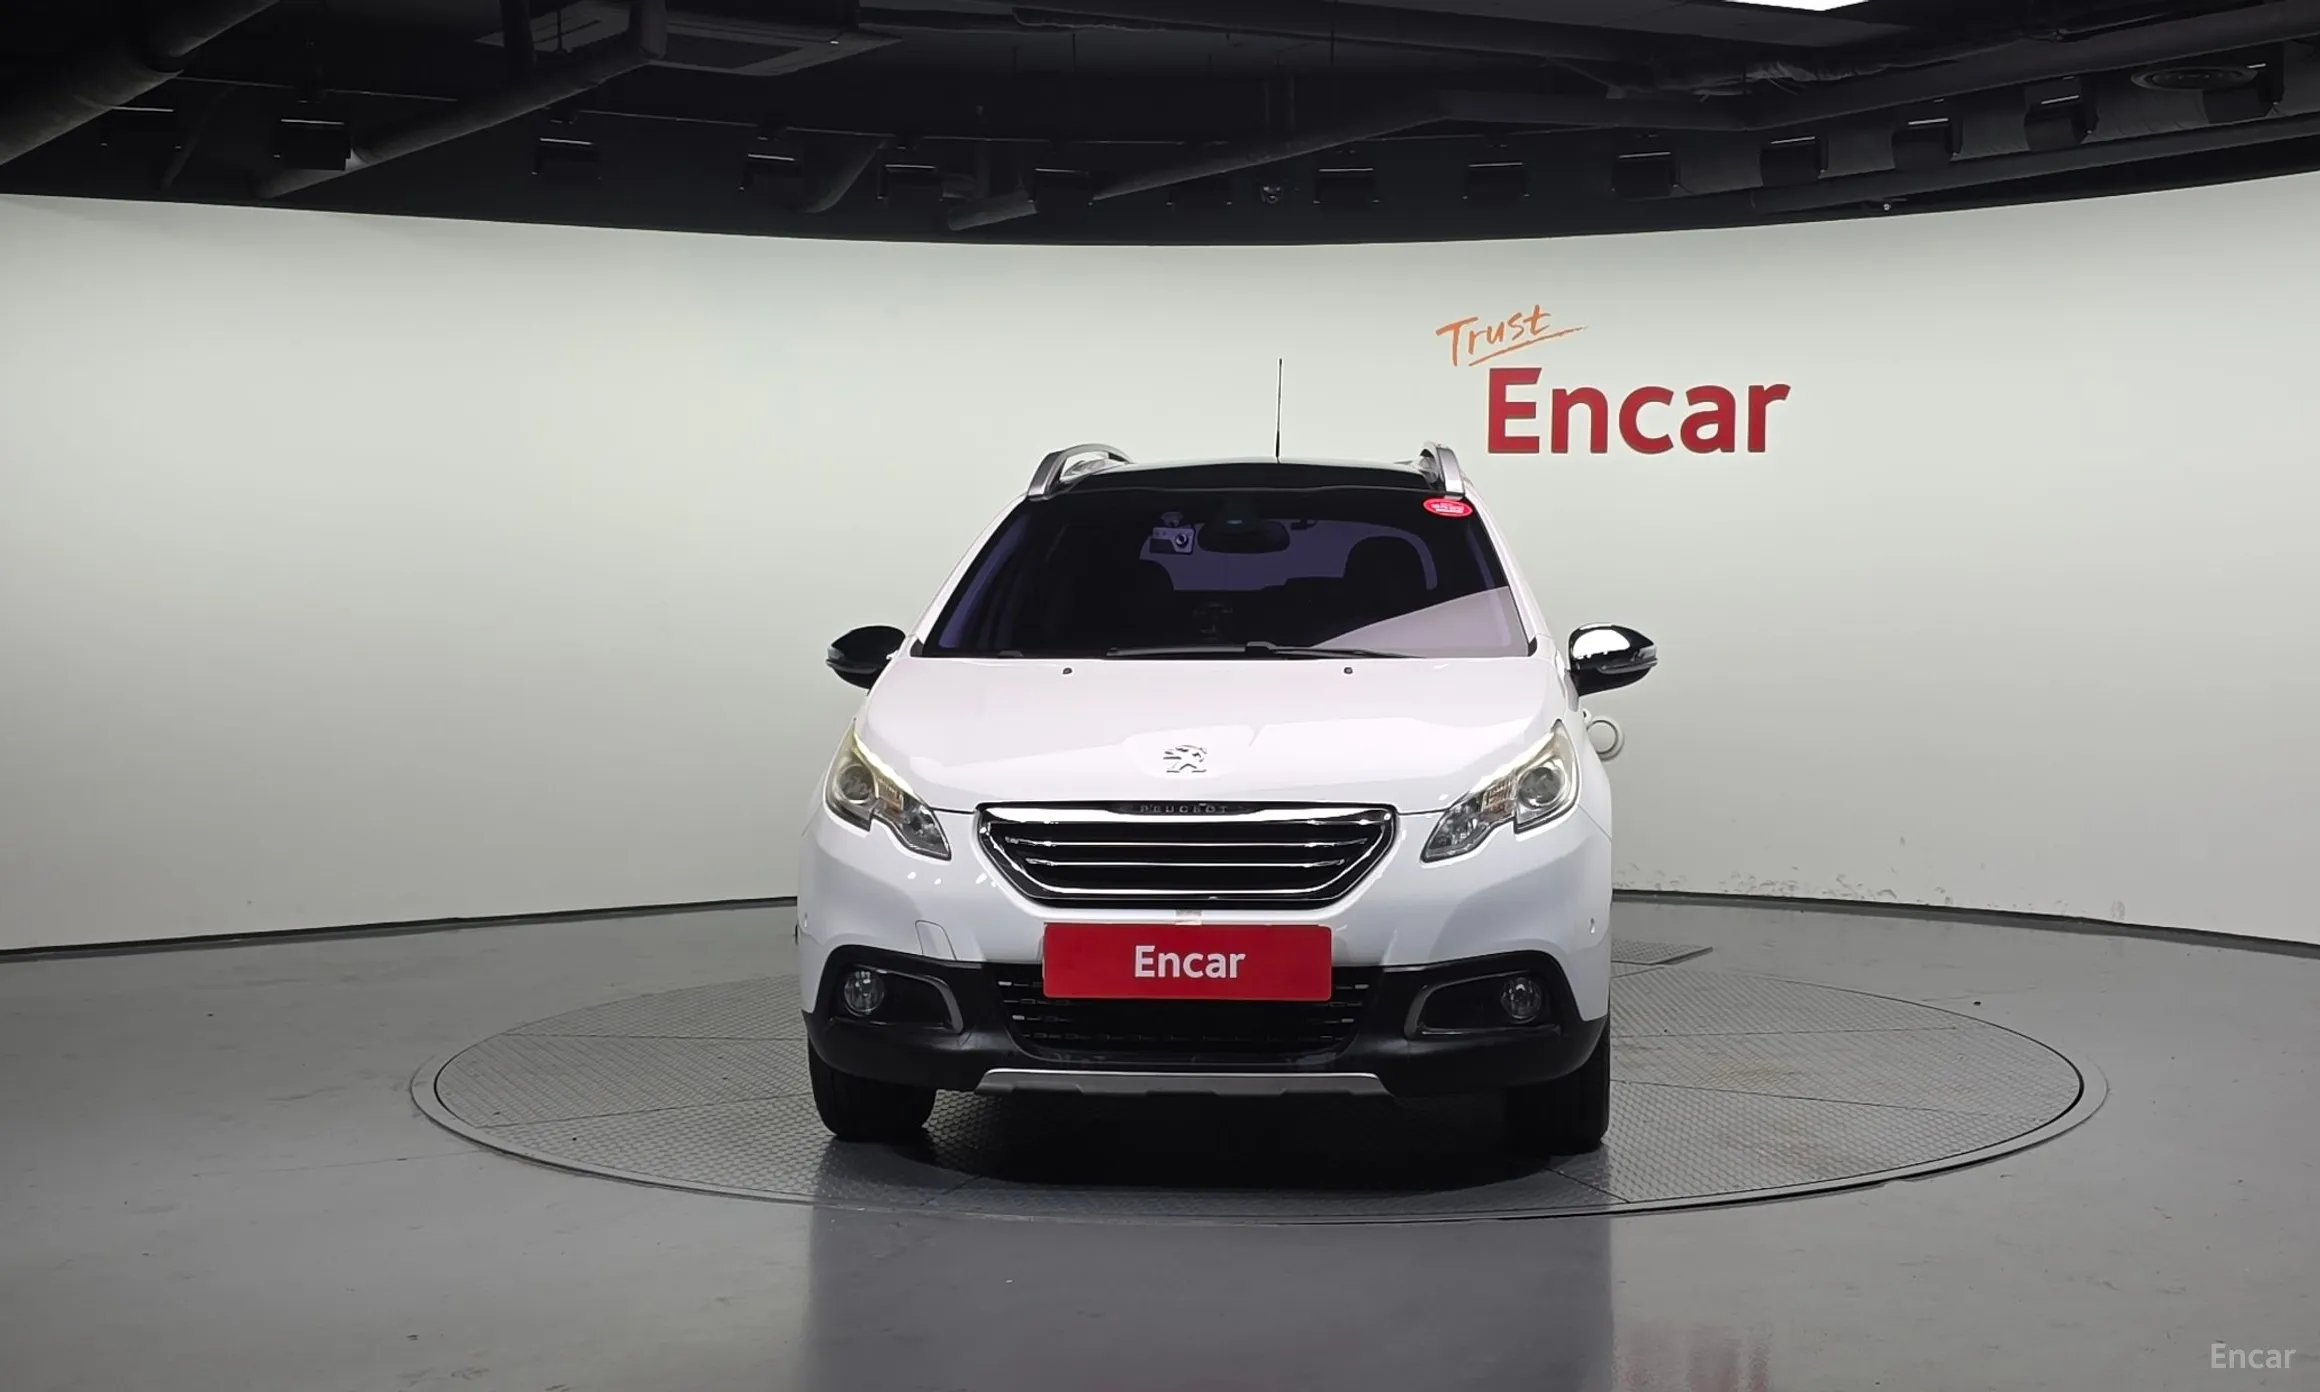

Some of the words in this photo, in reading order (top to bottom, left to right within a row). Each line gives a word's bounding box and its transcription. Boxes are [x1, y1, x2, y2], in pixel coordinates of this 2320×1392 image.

[1435, 304, 1552, 367] Trust
[1488, 367, 1791, 454] Encar
[1139, 803, 1229, 814] PEUGEOT
[1134, 945, 1246, 978] Encar
